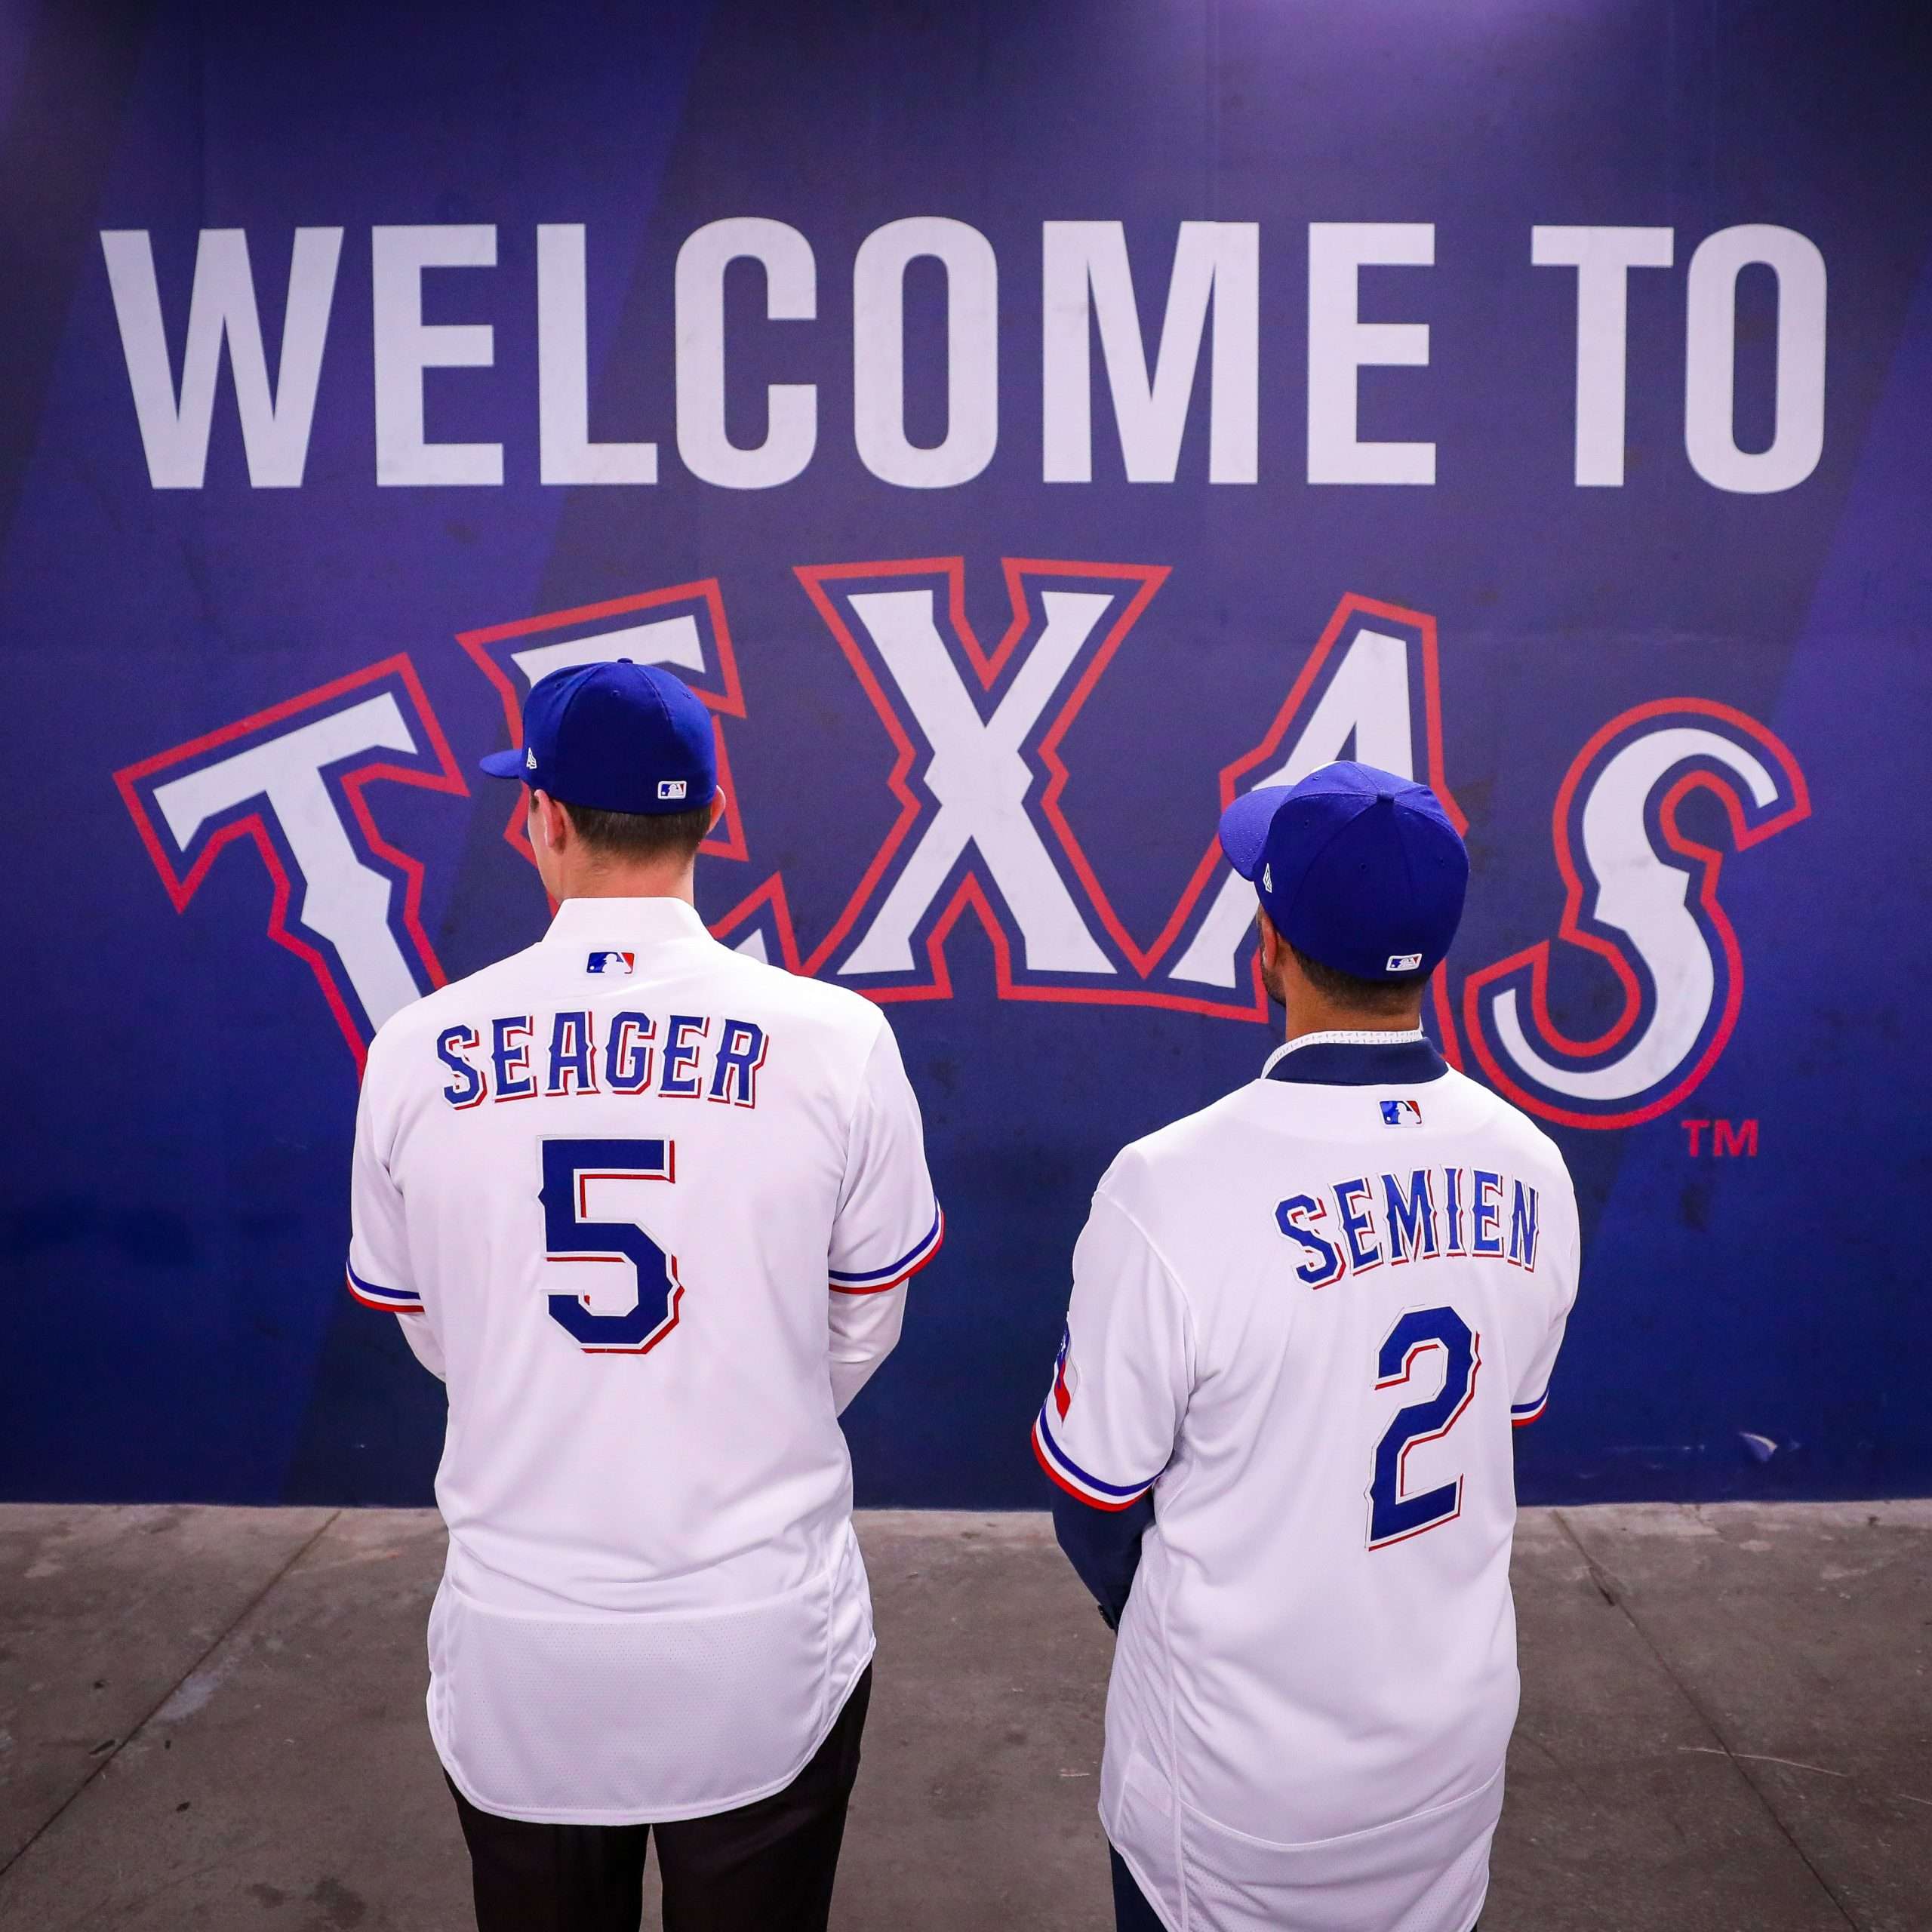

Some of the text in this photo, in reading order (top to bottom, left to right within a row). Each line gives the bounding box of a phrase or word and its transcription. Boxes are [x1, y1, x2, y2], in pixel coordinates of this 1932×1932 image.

[101, 217, 1826, 494] WELCOME TO
[435, 1011, 770, 1111] SEAGER
[1681, 1119, 1758, 1158] TM
[537, 1137, 685, 1356] 5
[1274, 1167, 1540, 1291] SEMIEN
[1367, 1305, 1482, 1552] 2
